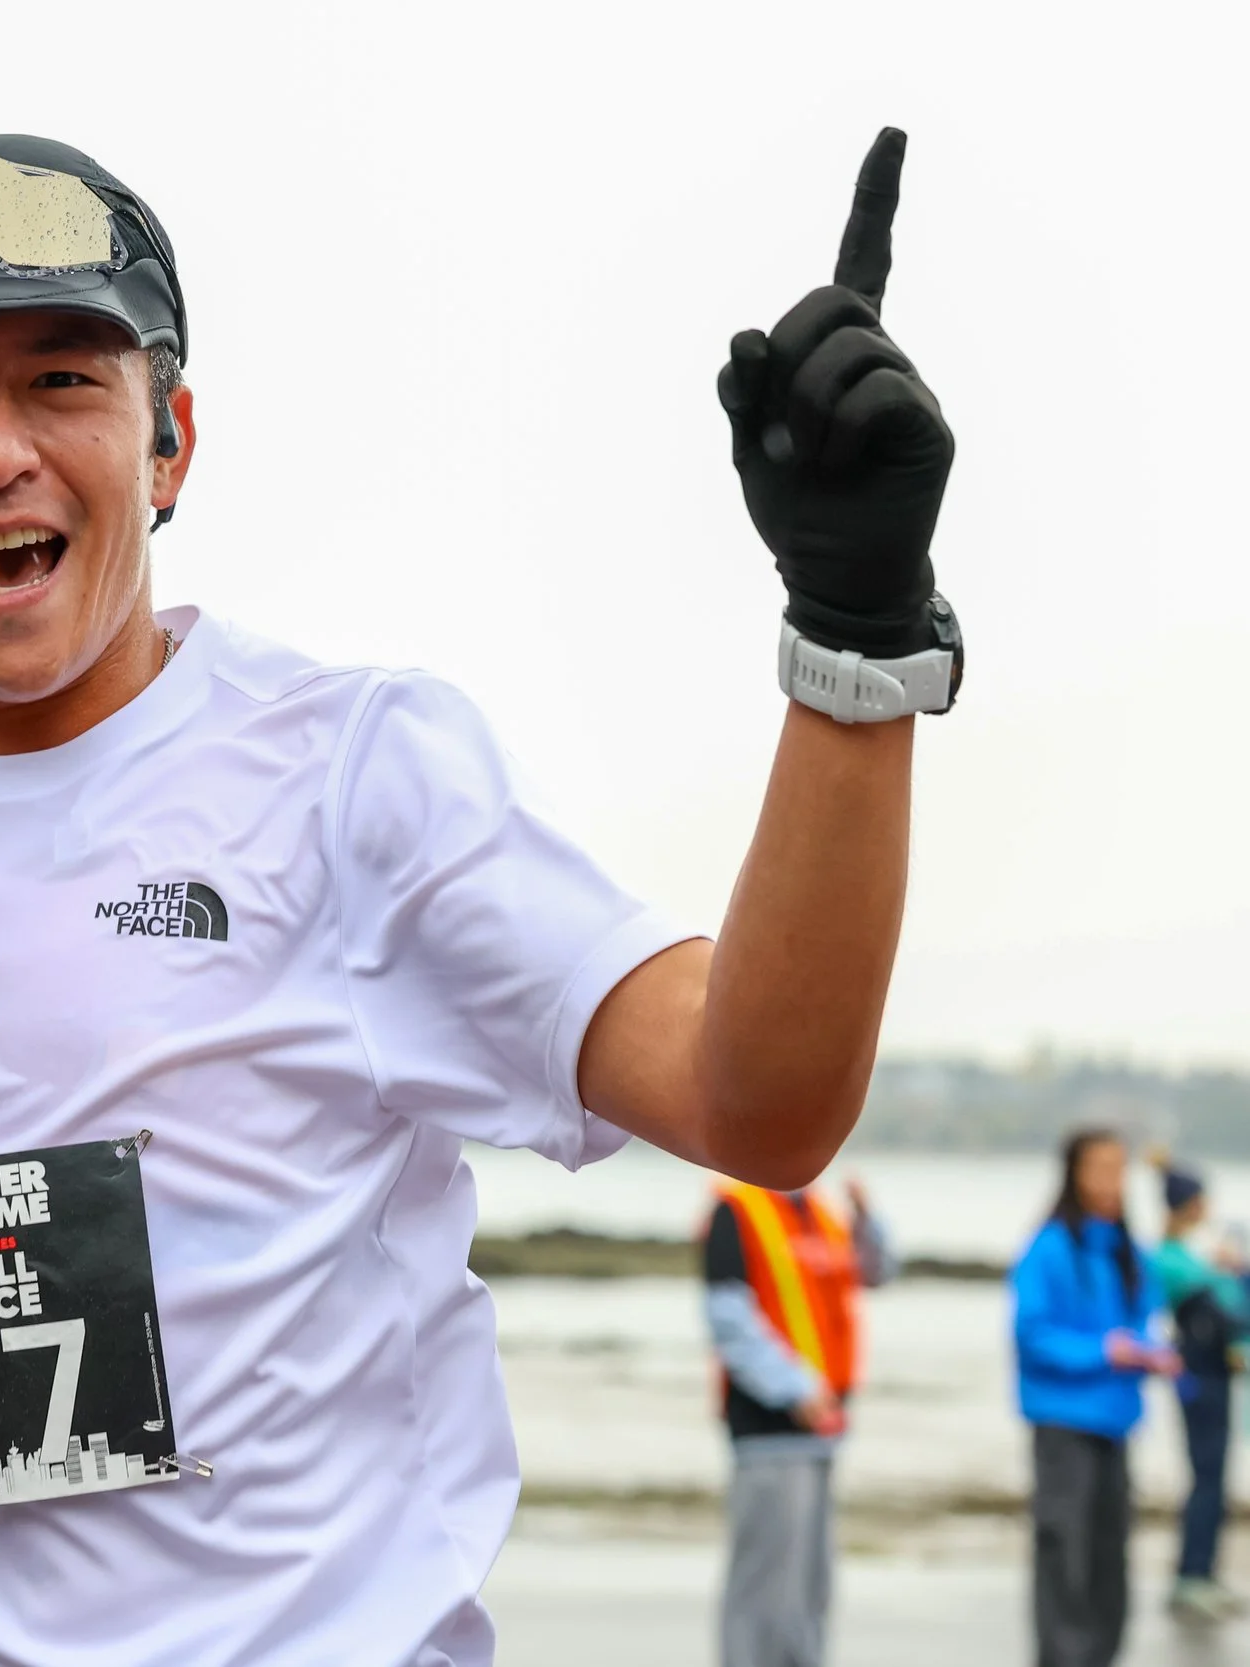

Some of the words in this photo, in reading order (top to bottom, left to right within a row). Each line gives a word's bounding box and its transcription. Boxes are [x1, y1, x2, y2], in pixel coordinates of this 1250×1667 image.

[138, 882, 185, 900] THE
[95, 900, 184, 918] NORTH
[116, 916, 181, 937] FACE
